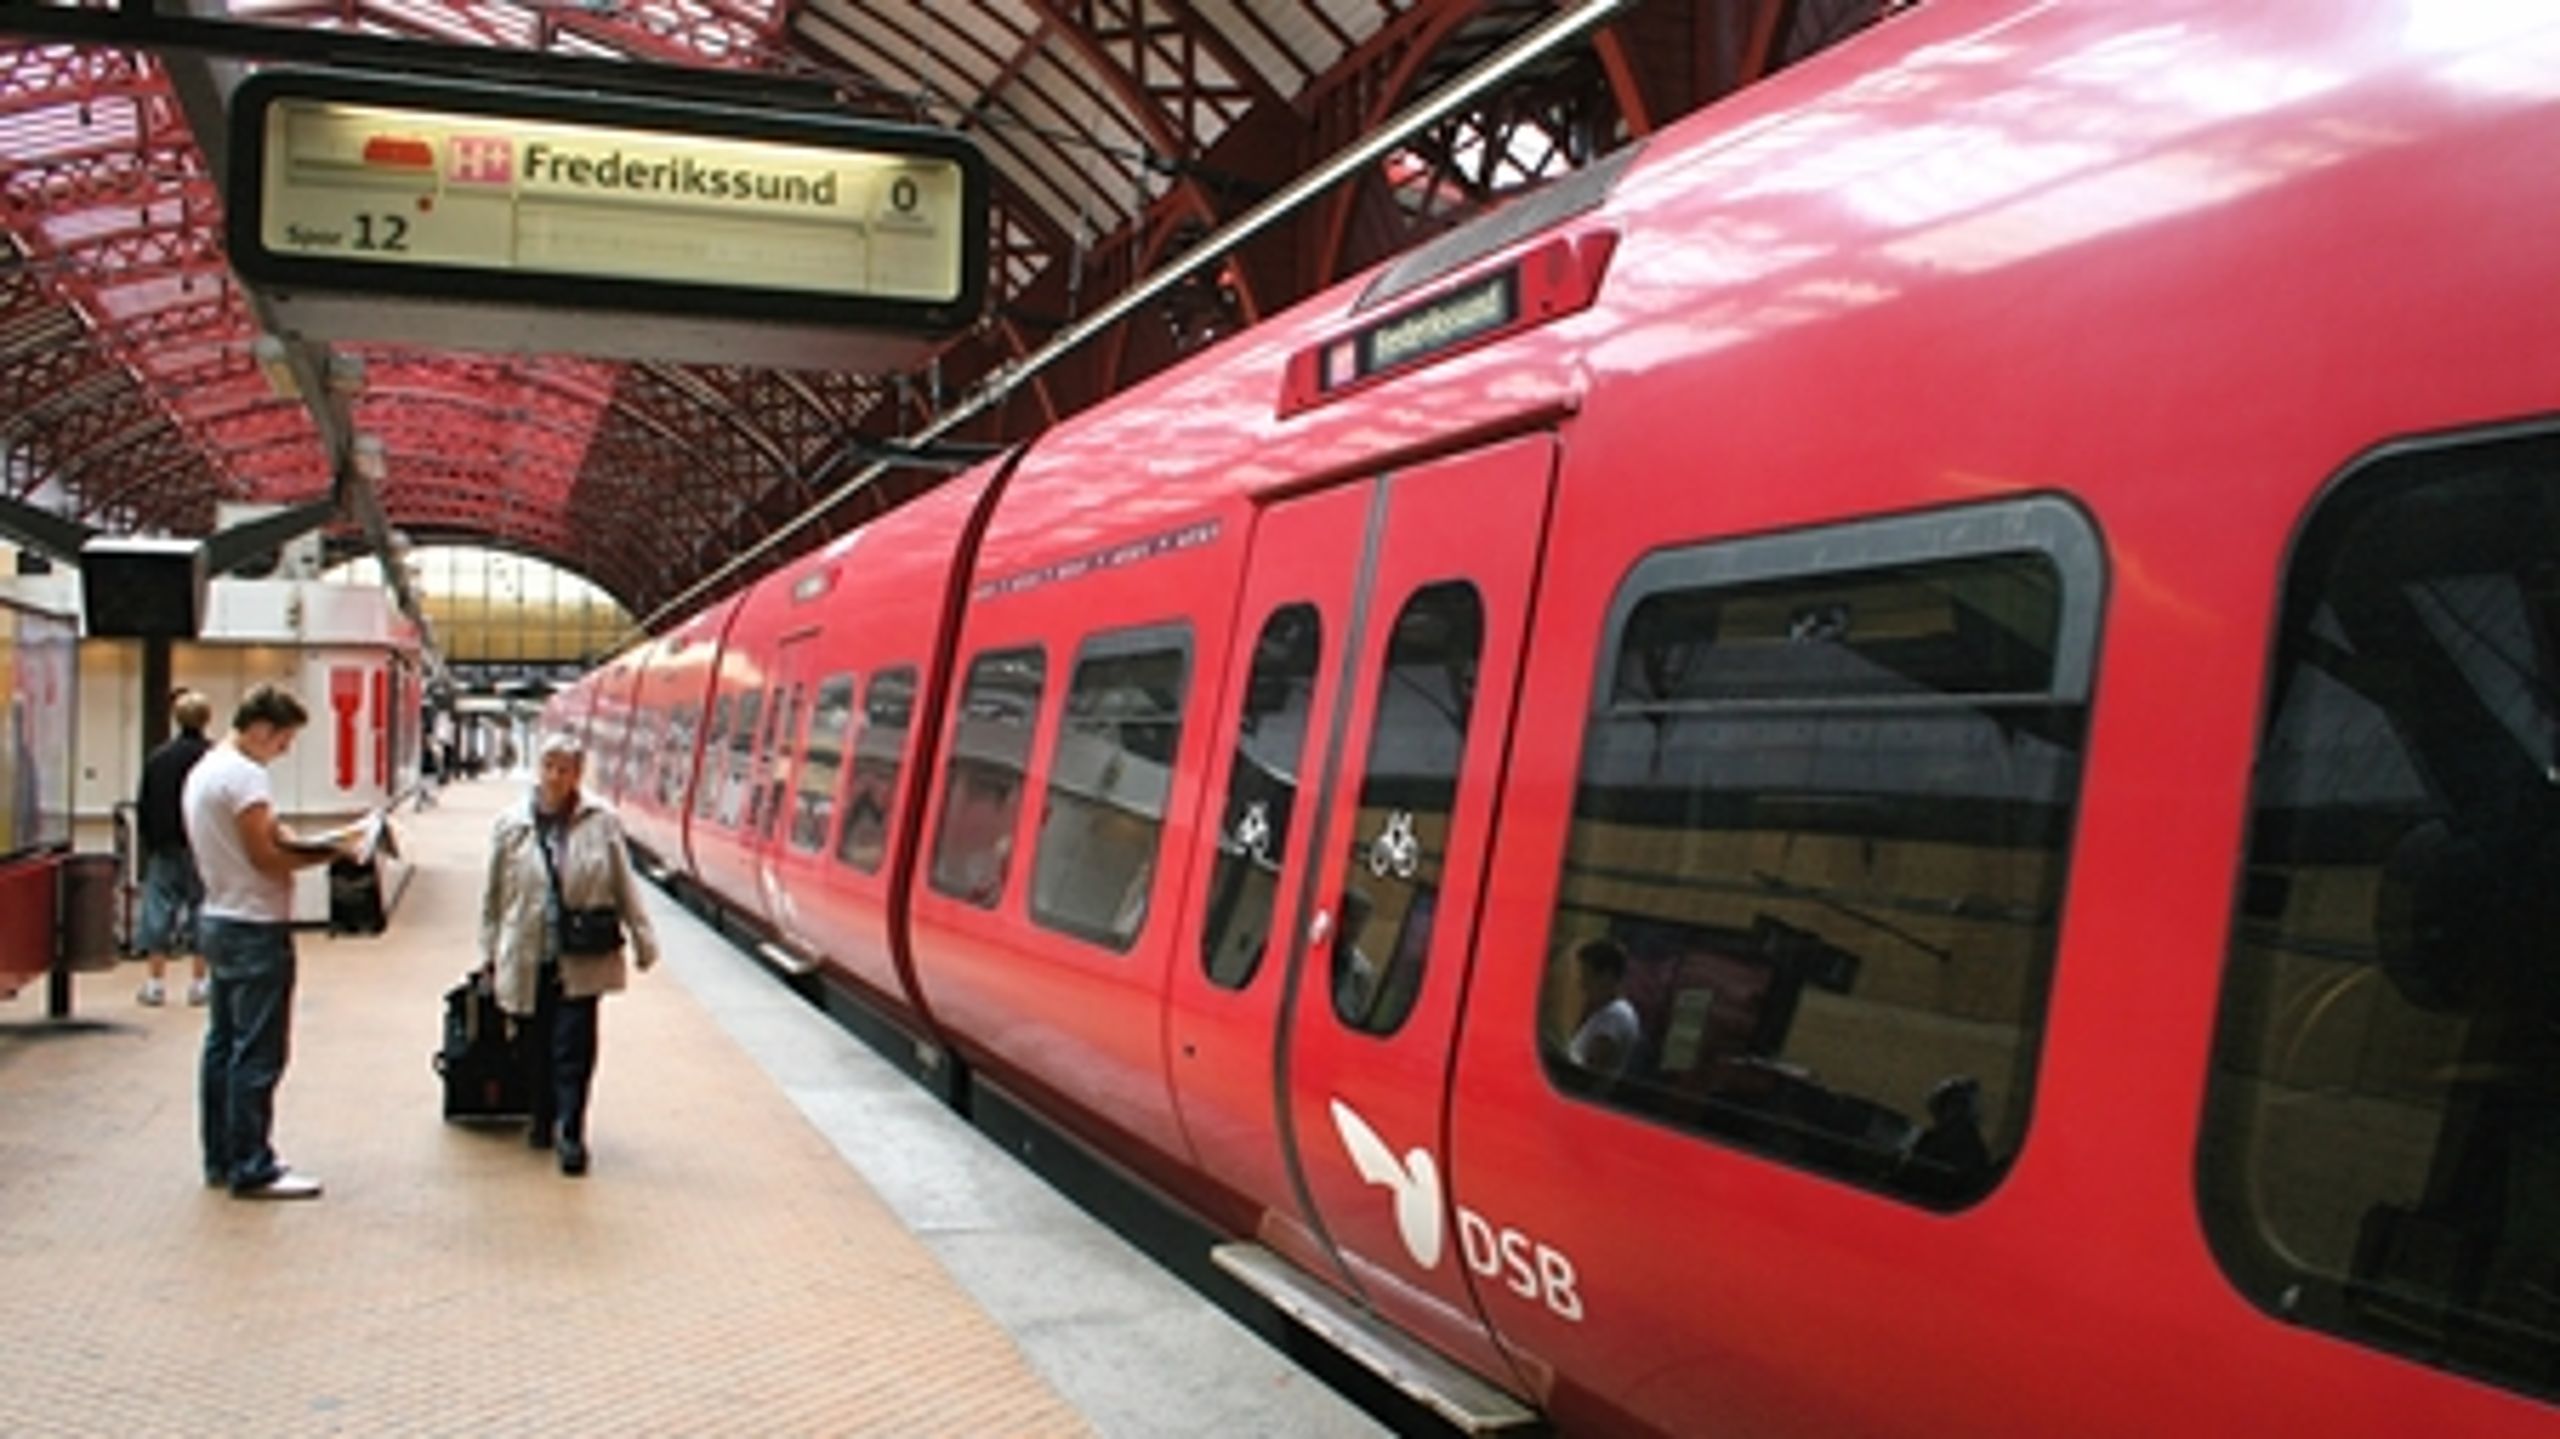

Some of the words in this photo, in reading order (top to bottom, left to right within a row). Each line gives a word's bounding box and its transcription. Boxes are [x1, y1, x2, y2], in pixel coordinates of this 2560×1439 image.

[522, 142, 838, 206] Frederikssund
[354, 213, 409, 252] 12
[1456, 1205, 1584, 1321] DSB
